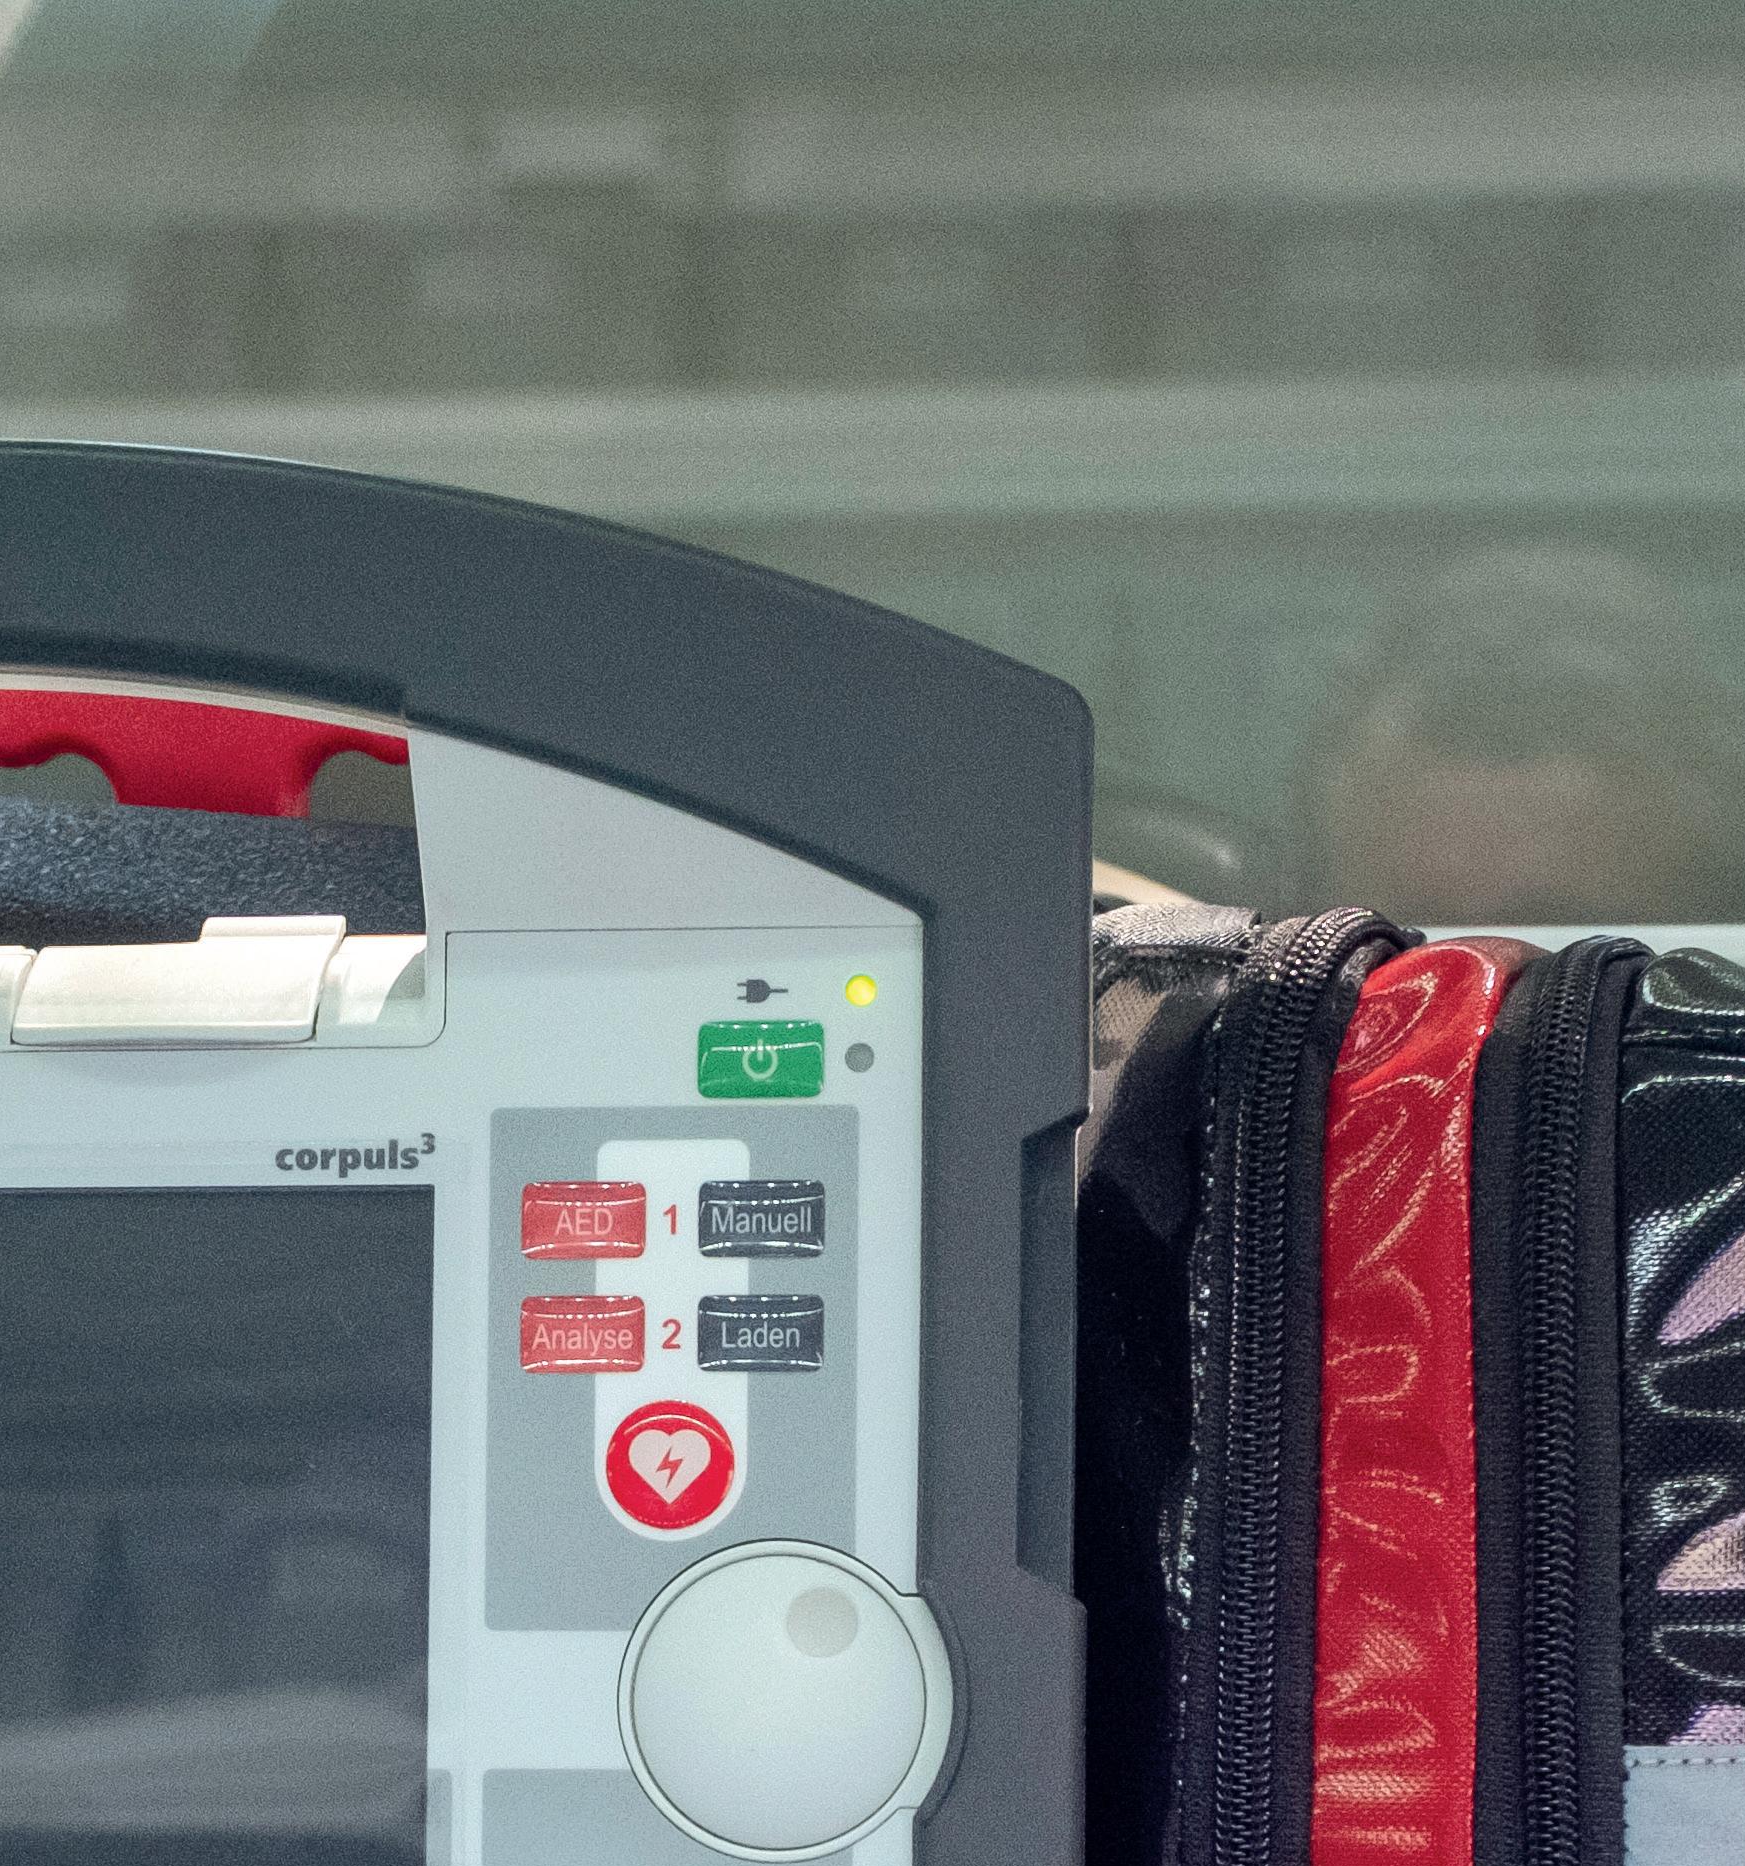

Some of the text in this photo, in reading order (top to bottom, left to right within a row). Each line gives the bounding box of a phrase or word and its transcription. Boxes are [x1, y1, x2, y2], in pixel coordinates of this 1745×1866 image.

[556, 1208, 612, 1235] AED
[664, 1205, 677, 1235] 1
[713, 1206, 810, 1233] Manuell
[533, 1324, 632, 1356] Analyse
[662, 1319, 681, 1349] 2
[722, 1322, 799, 1348] Laden
